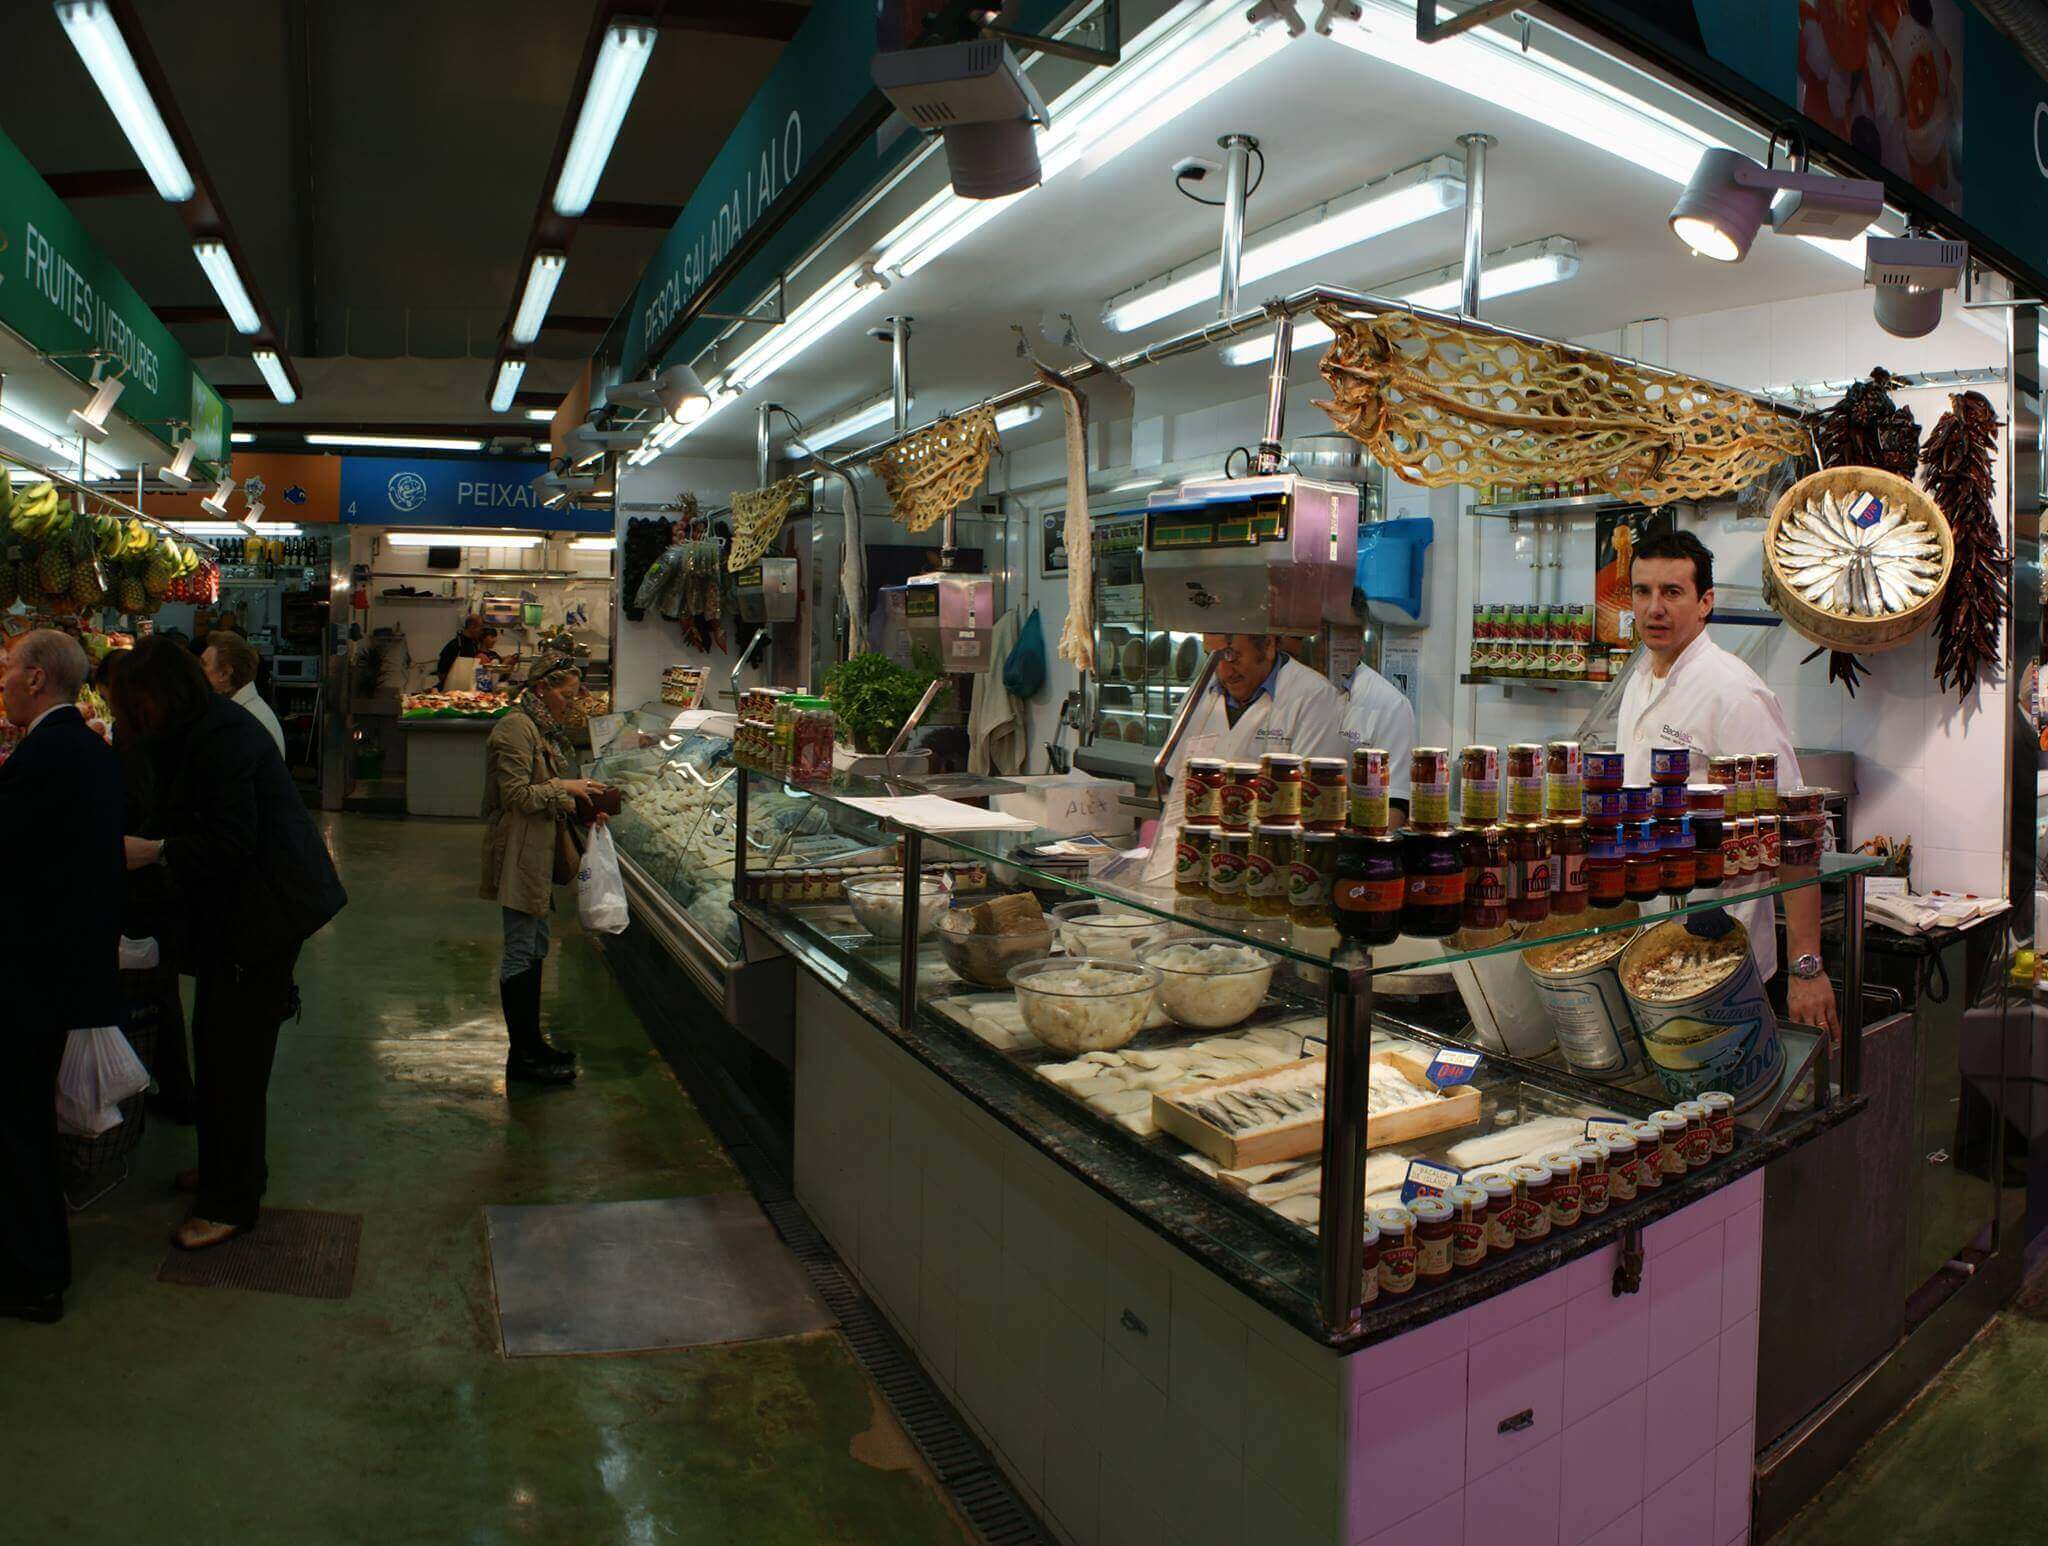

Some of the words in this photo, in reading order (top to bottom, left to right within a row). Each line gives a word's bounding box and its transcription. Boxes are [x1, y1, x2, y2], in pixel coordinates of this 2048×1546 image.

[25, 222, 93, 335] FRUITES
[101, 301, 159, 395] VERDURES
[347, 500, 358, 517] 4
